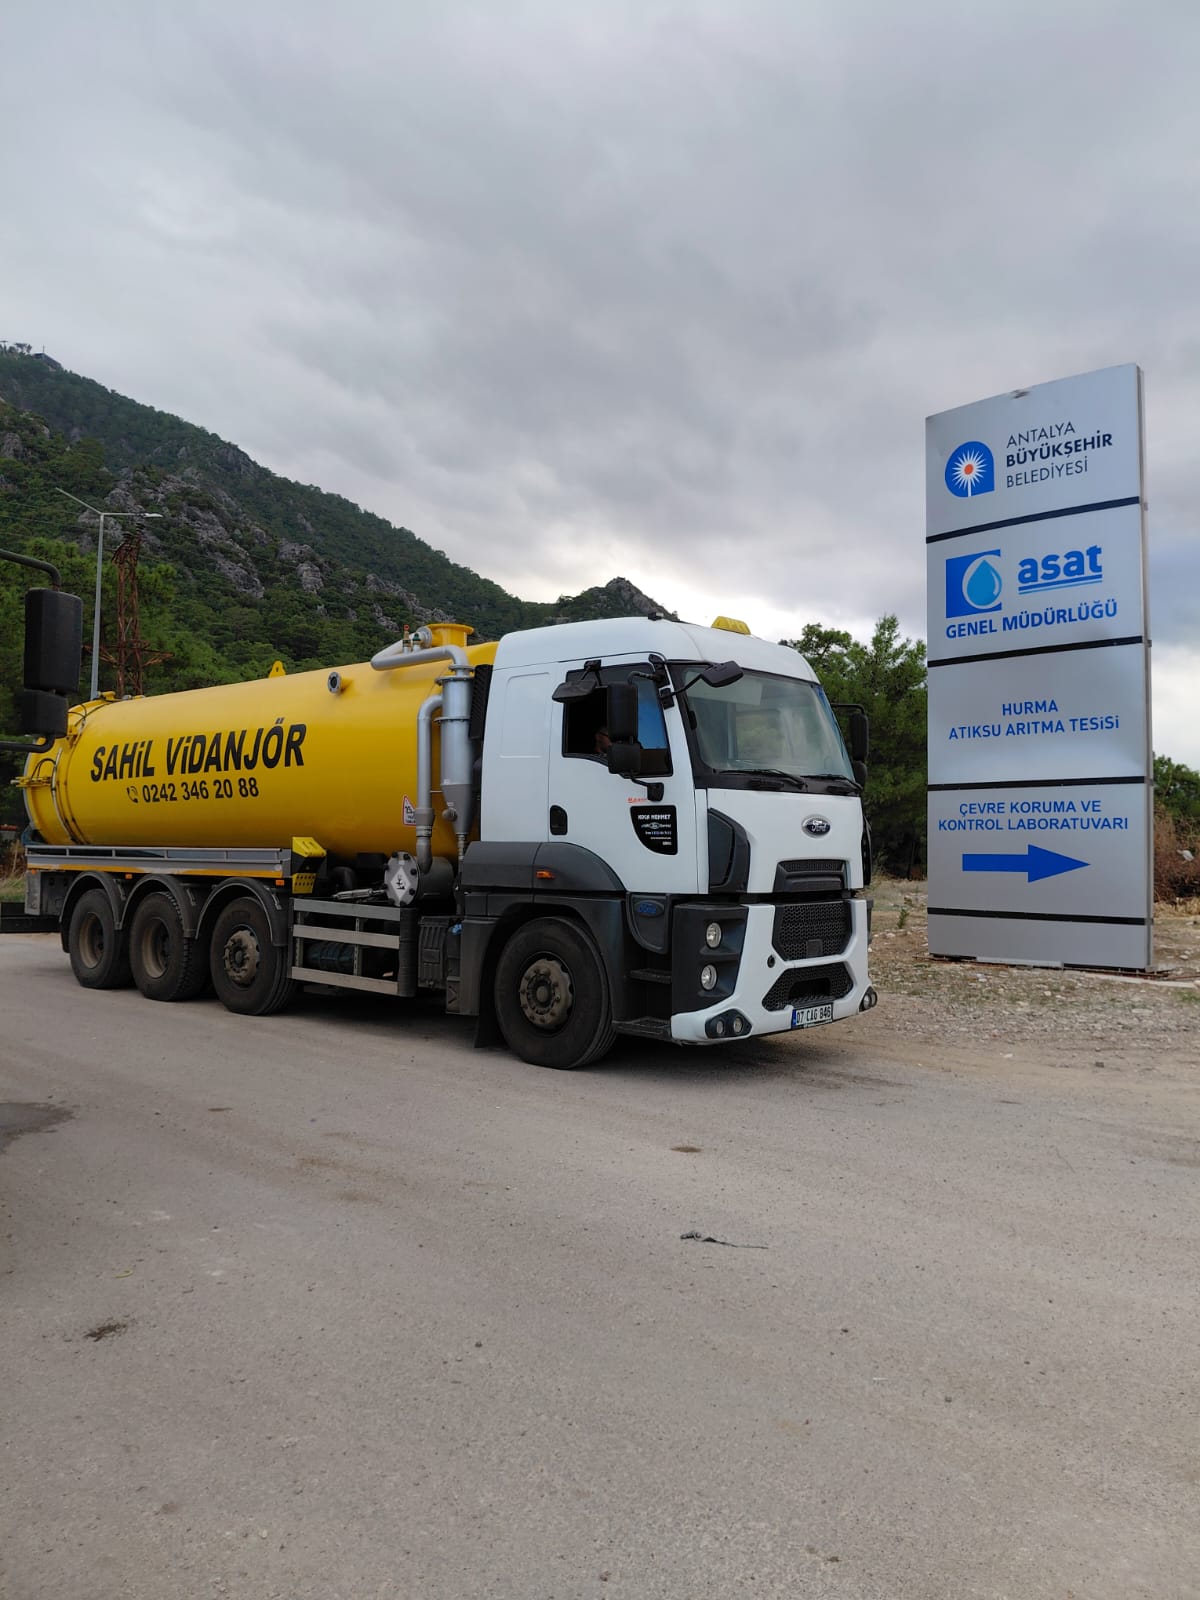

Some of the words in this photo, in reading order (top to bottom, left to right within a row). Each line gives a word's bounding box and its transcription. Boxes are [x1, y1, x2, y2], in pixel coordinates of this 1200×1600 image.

[1006, 421, 1076, 448] ANTALYA
[1006, 430, 1113, 467] BÜYÜKŞEHİR
[1006, 456, 1088, 488] BELEDİYESİ
[1018, 545, 1102, 585] asat
[946, 619, 997, 639] GENEL
[1002, 599, 1117, 632] MÜDÜRLÜĞÜ
[1002, 700, 1058, 716] HURMA
[949, 725, 1001, 740] ATIKSU
[1005, 720, 1065, 736] ARITMA
[142, 782, 177, 803] 0242
[181, 780, 209, 800] 346
[213, 778, 233, 799] 20
[239, 777, 259, 797] 88
[959, 802, 1006, 817] ÇEVRE
[1010, 801, 1076, 814] KORUMA
[1080, 800, 1101, 813] VE
[938, 819, 1003, 831] KONTROL
[1008, 817, 1128, 830] LABORATUVARI
[796, 1011, 804, 1024] 07
